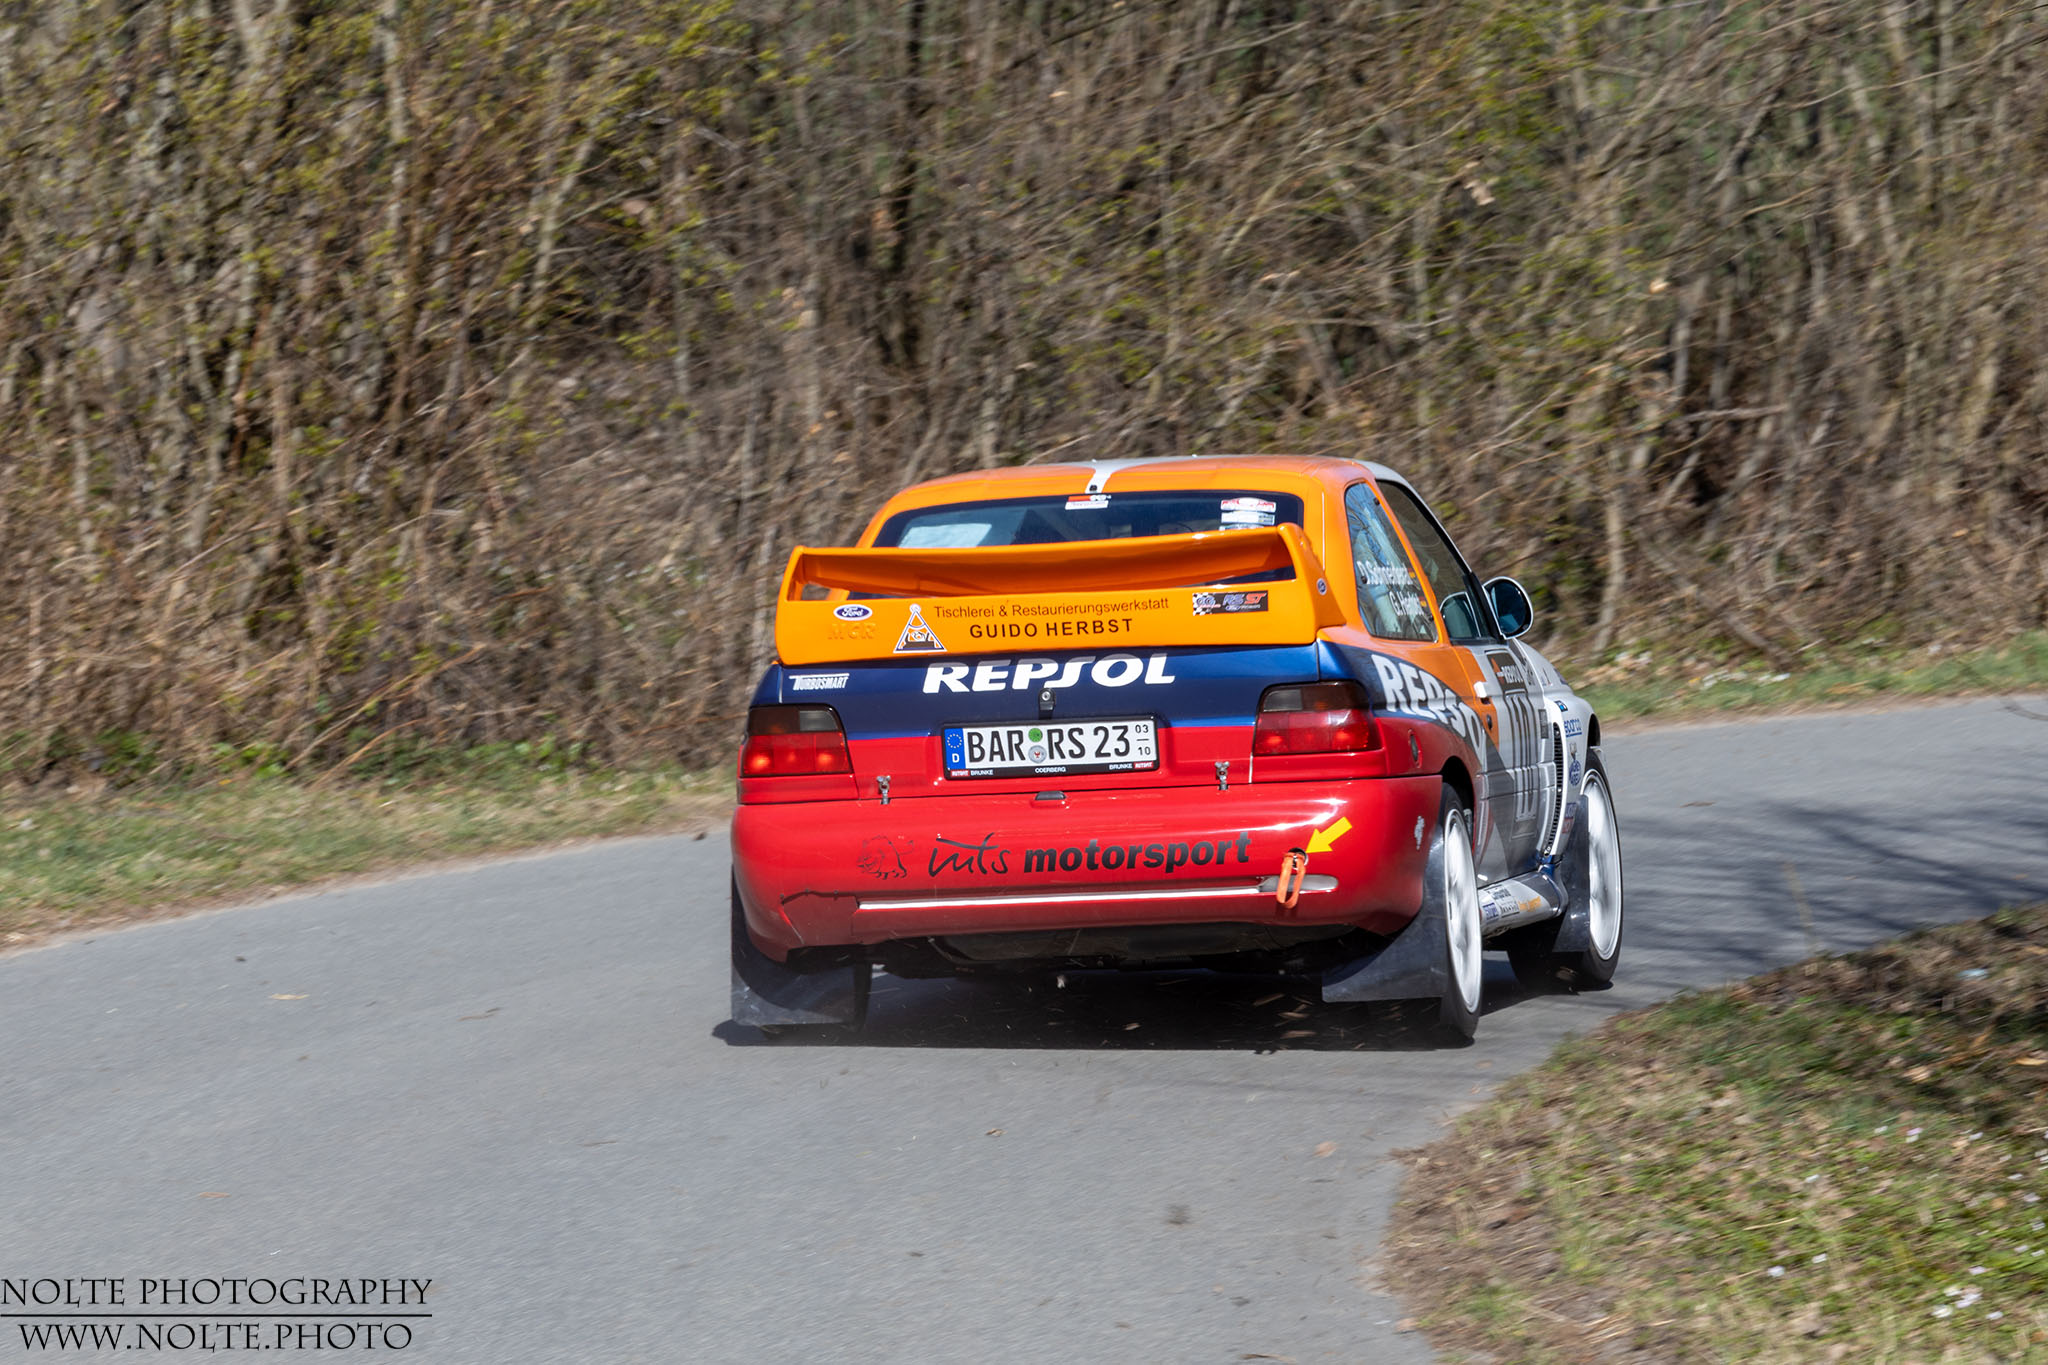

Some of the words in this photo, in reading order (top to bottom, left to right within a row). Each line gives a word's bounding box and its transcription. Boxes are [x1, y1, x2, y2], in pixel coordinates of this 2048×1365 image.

[934, 605, 994, 618] Tischlerei
[999, 606, 1008, 617] &
[1012, 598, 1169, 617] Restaurierungswerkstatt
[970, 623, 1037, 638] GUIDO
[1046, 619, 1133, 637] HERBST
[789, 673, 850, 690] TURBOSMART
[923, 653, 1176, 694] REPSOL
[1135, 724, 1149, 734] 03
[967, 730, 1026, 763] BAR
[1047, 728, 1086, 760] RS
[1093, 725, 1131, 758] 23
[1138, 746, 1151, 756] 10
[952, 753, 960, 763] D
[1035, 766, 1066, 774] ODERBERG
[1023, 832, 1252, 873] motorsport
